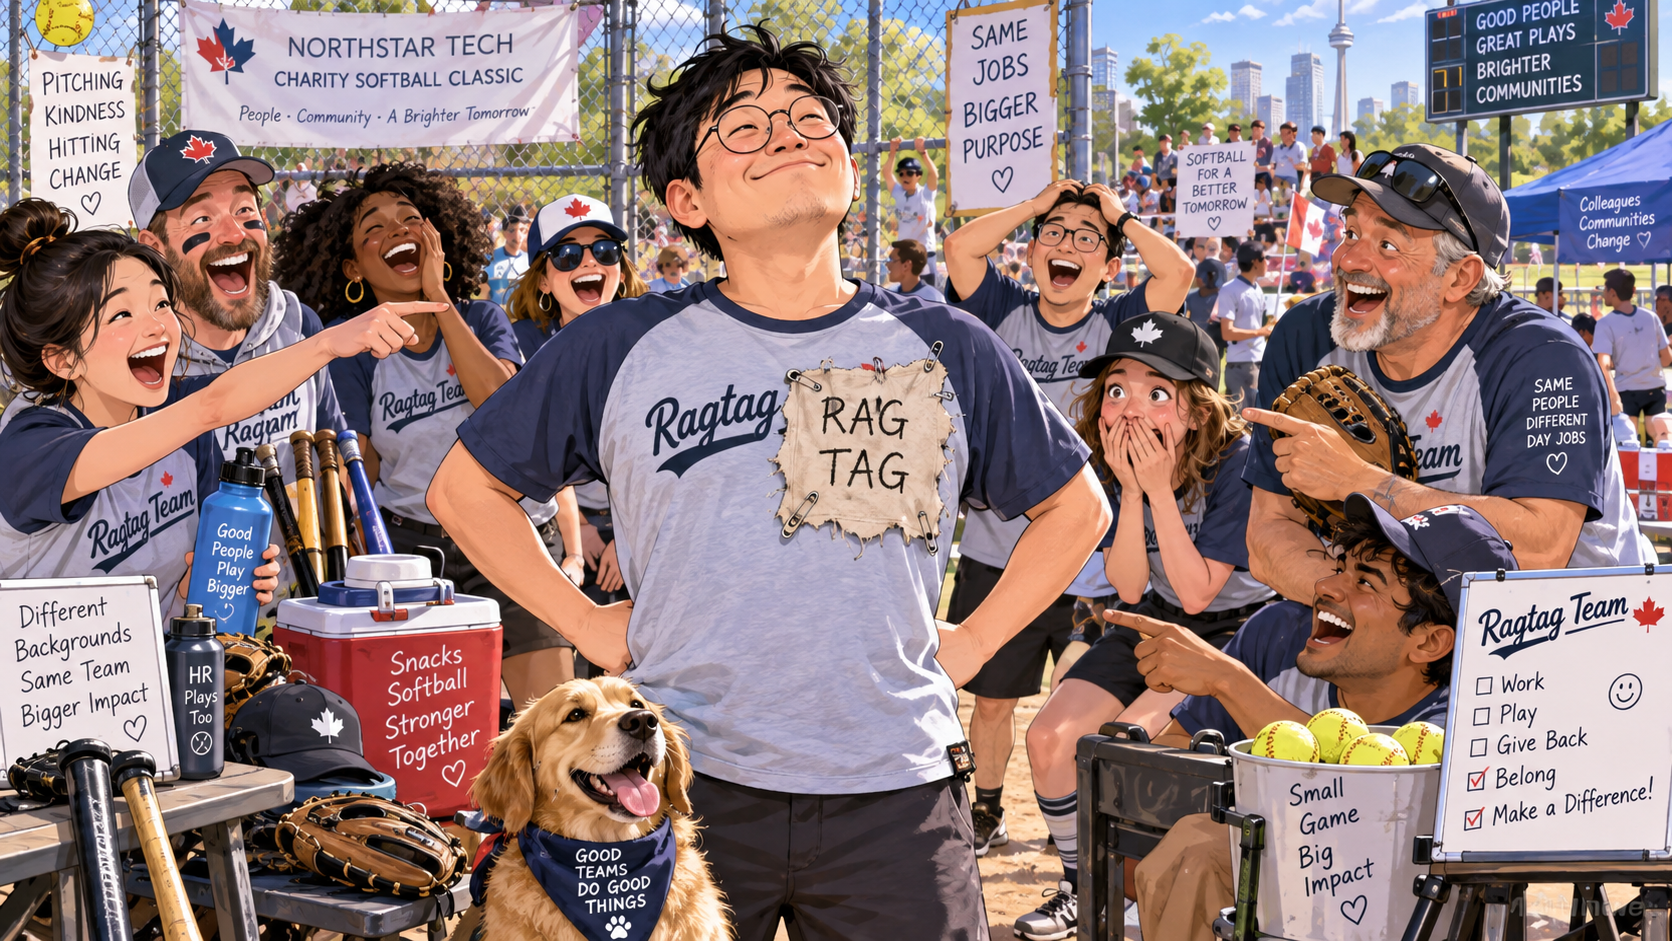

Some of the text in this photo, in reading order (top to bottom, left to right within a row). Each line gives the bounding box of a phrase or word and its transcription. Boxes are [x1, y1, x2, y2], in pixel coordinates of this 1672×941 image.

[1477, 8, 1516, 30] GOOD
[1523, 0, 1579, 22] PEOPLE
[289, 34, 512, 58] NORTHSTAR TECH
[972, 19, 1027, 49] SAME
[1477, 23, 1575, 55] GREAT PLAYS
[275, 68, 522, 88] CHARITY SOFTBALL CLASSIC
[973, 53, 1028, 85] JOBS
[1478, 54, 1550, 79] BRIGHTER
[1477, 74, 1582, 103] COMMUNITIES
[240, 105, 281, 126] People
[297, 109, 371, 128] Community
[387, 109, 397, 123] A
[405, 108, 460, 127] Brighter
[964, 92, 1038, 127] BIGGER
[964, 126, 1043, 163] PURPOSE
[1187, 151, 1246, 166] SOFTBALL
[50, 162, 121, 189] CHANGE
[1198, 167, 1231, 180] FOR A
[1193, 182, 1236, 197] BETTER
[1183, 198, 1247, 213] TOMORROW
[1580, 196, 1640, 213] Colleagues
[1580, 213, 1654, 230] Communities
[1587, 233, 1630, 252] Change
[1061, 355, 1090, 374] Tea
[1535, 377, 1572, 393] SAME
[379, 380, 465, 421] Ragtag Tea
[1533, 395, 1579, 411] PEOPLE
[645, 384, 781, 456] Ragtag
[821, 396, 909, 439] RAG
[1527, 414, 1587, 429] DIFFERENT
[1528, 431, 1585, 448] DAY JOBS
[819, 448, 909, 494] TAG
[87, 491, 195, 559] Ragtag Team
[218, 523, 252, 540] Good
[212, 542, 253, 562] People
[217, 562, 245, 581] Play
[207, 579, 249, 600] Bigger
[20, 597, 107, 628] Different
[1478, 592, 1629, 647] Ragtag Team
[15, 622, 131, 662] Backgrounds
[391, 644, 462, 675] Snacks
[22, 660, 129, 692] Same Team
[190, 666, 212, 684] HR
[388, 667, 467, 706] Softball
[1502, 672, 1544, 693] Work
[21, 683, 148, 731] Bigger Impact
[185, 690, 218, 708] Plays
[190, 710, 212, 724] Too
[385, 700, 475, 740] Stronger
[1501, 703, 1537, 728] Play
[388, 729, 480, 770] Together
[1498, 727, 1587, 754] Give Back
[1496, 765, 1555, 790] Belong
[1290, 777, 1343, 806] Small
[1493, 776, 1653, 825] Make a Difference!
[1300, 809, 1359, 834] Game
[576, 848, 621, 862] GOOD
[1299, 845, 1332, 870] Big
[576, 864, 627, 878] TEAMS
[1304, 858, 1374, 896] Impact
[578, 876, 650, 896] DO GOOD
[585, 894, 646, 914] THINGS
